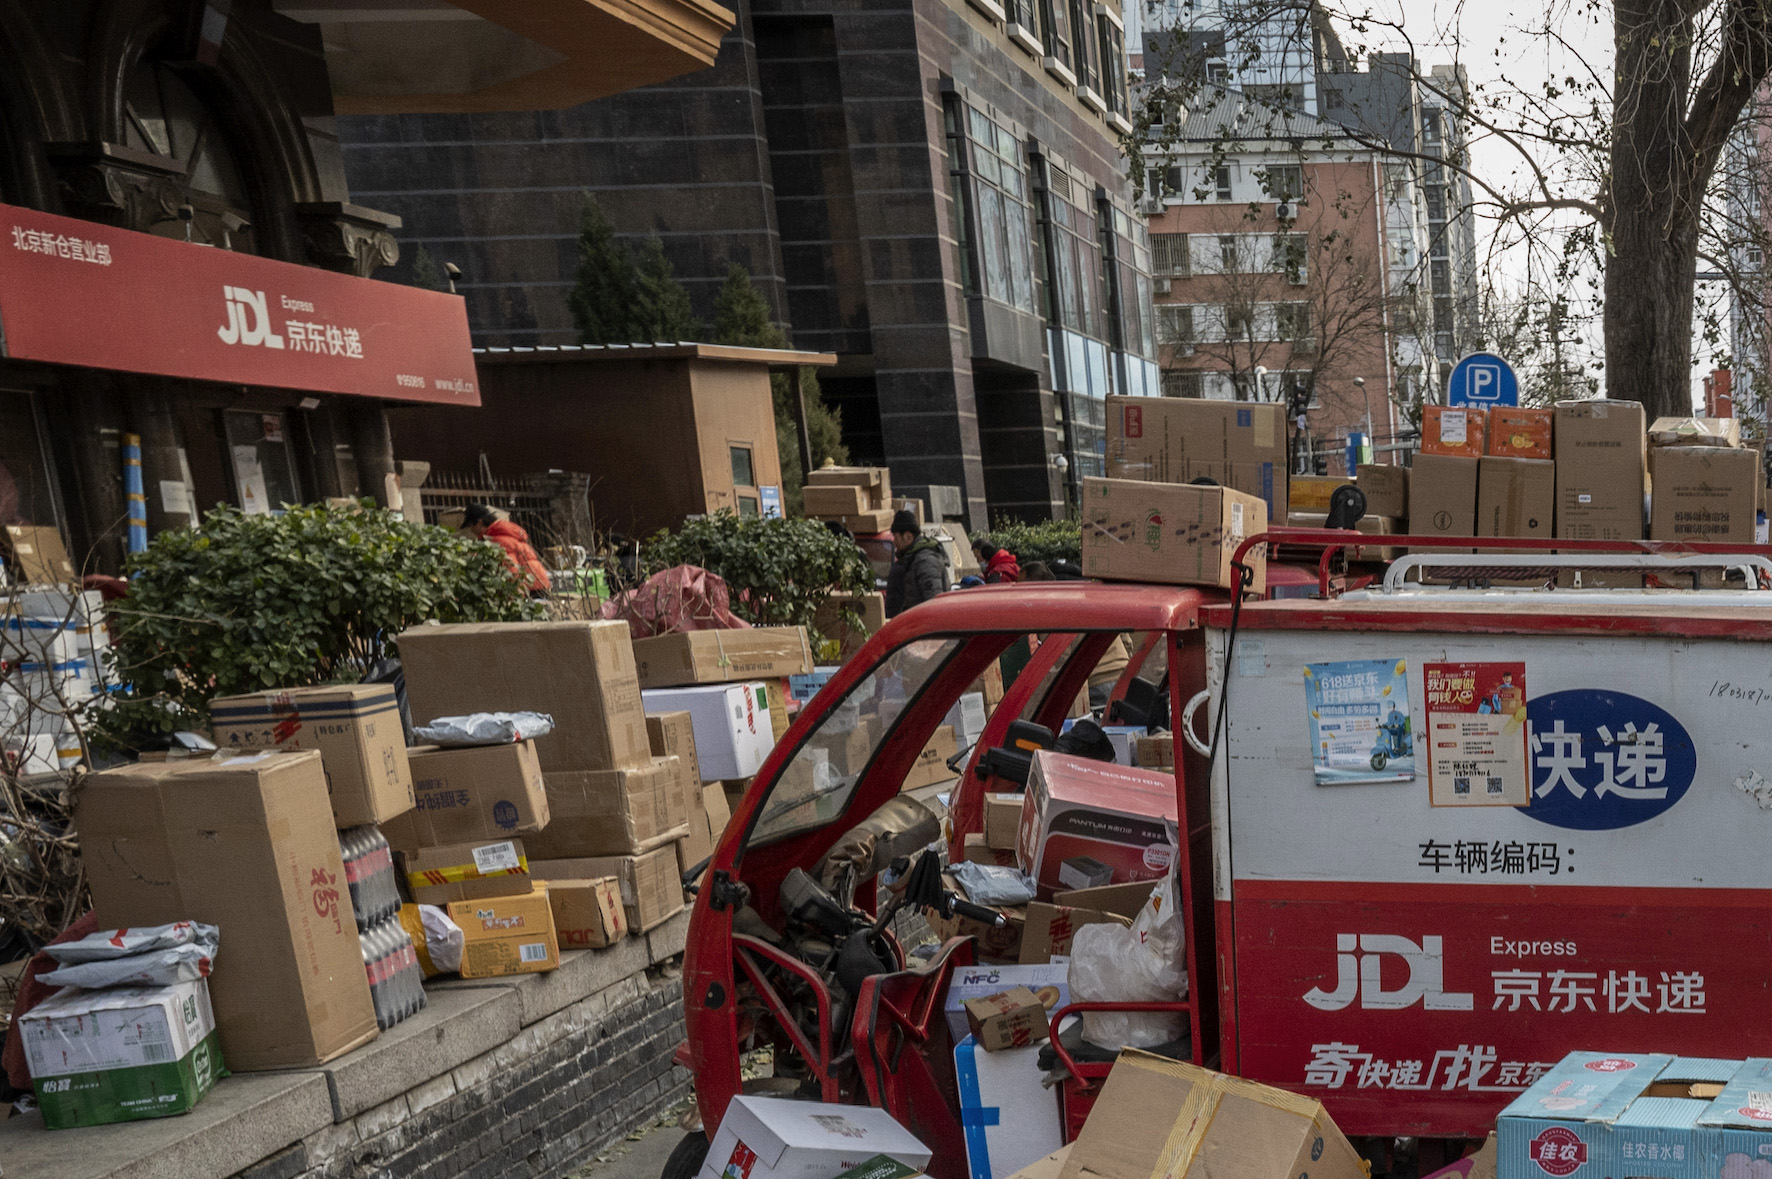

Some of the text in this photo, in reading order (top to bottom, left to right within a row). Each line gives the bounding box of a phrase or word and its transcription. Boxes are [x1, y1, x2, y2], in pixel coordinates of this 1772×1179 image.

[11, 225, 112, 266] 北京新仓营业部
[217, 285, 284, 350] JDL
[281, 294, 314, 313] Express
[286, 319, 364, 359] 京东快递
[1527, 719, 1670, 801] 快递
[1490, 936, 1578, 958] Express
[1302, 933, 1475, 1012] JDL
[1491, 968, 1707, 1015] 京东快递
[1539, 1141, 1579, 1161] 佳农
[1622, 1141, 1685, 1161] 佳农香水椰
